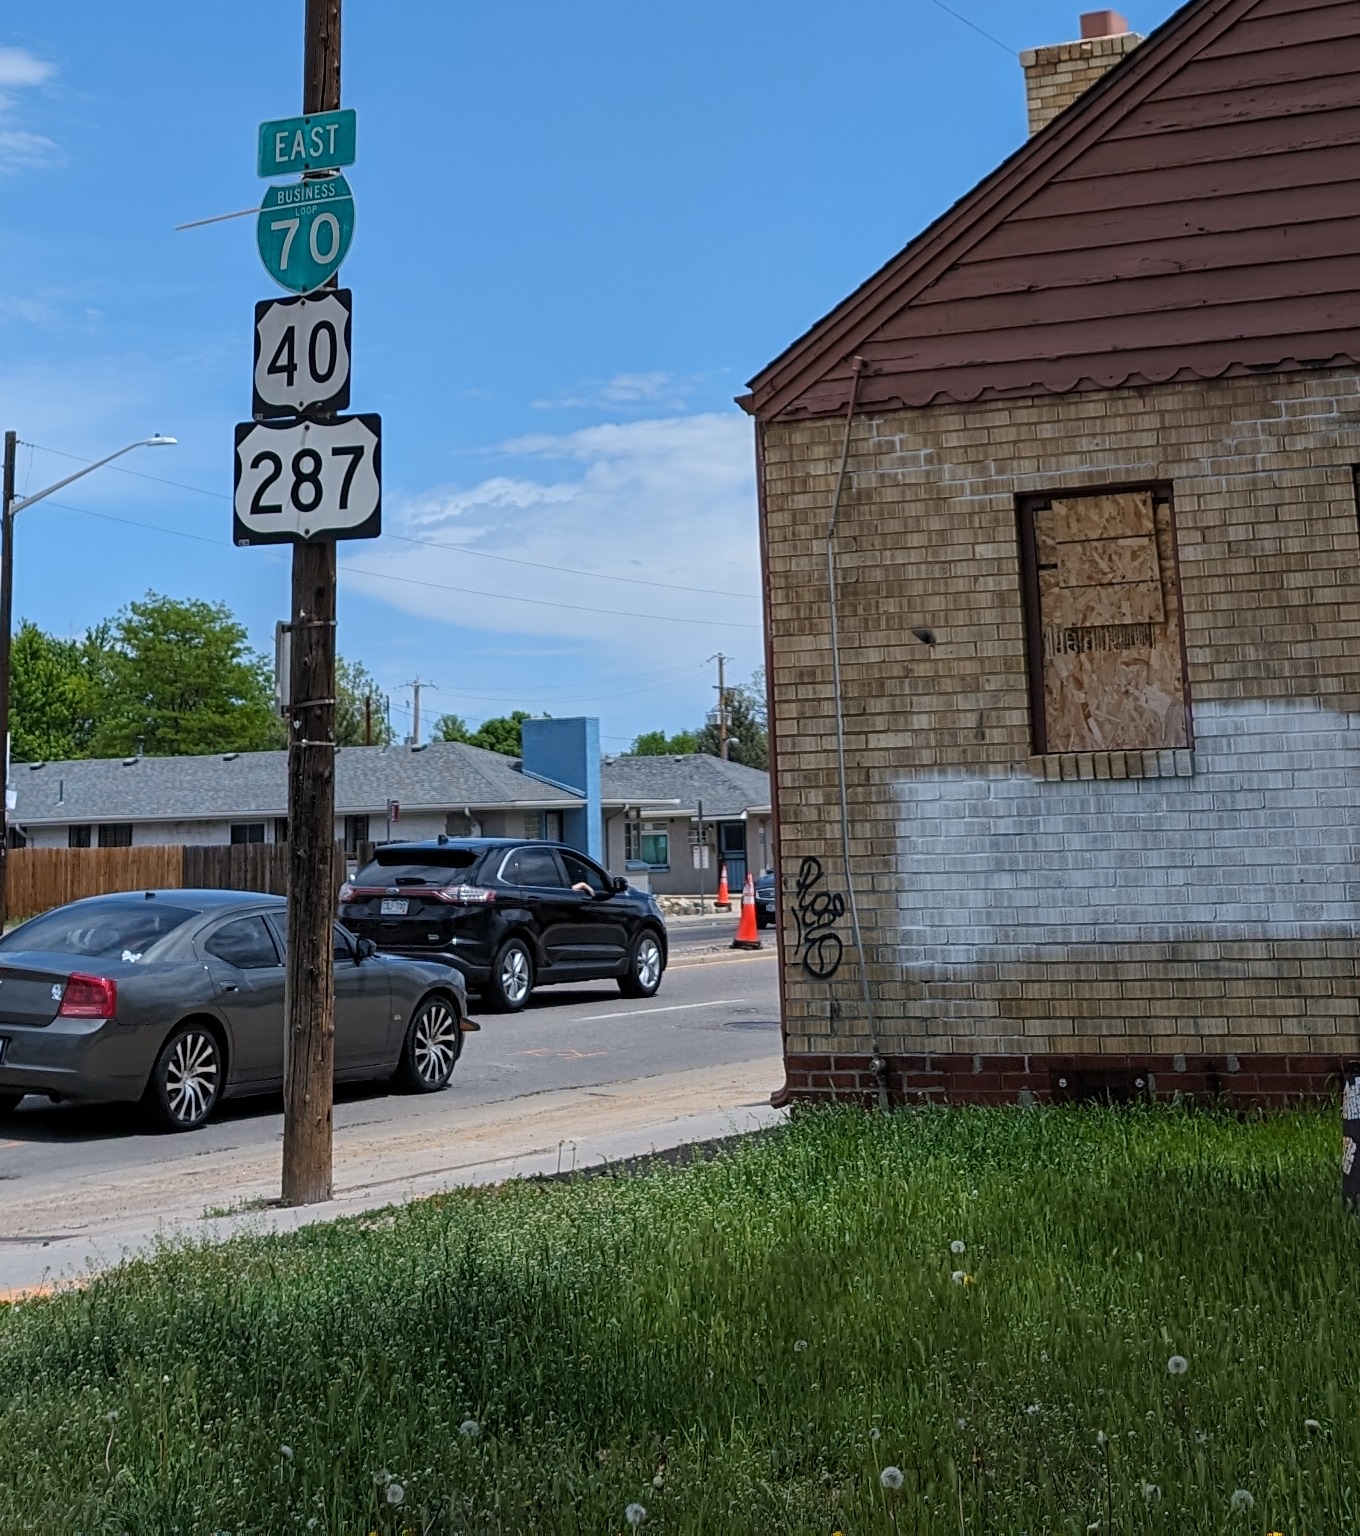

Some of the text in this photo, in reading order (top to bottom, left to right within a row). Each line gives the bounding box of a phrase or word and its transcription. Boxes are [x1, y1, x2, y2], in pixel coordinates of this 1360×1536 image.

[275, 123, 339, 163] EAST
[277, 183, 336, 205] BUSINESS
[295, 204, 318, 217] LOOP
[270, 212, 341, 271] 70
[267, 319, 337, 387] 40
[249, 444, 365, 516] 287
